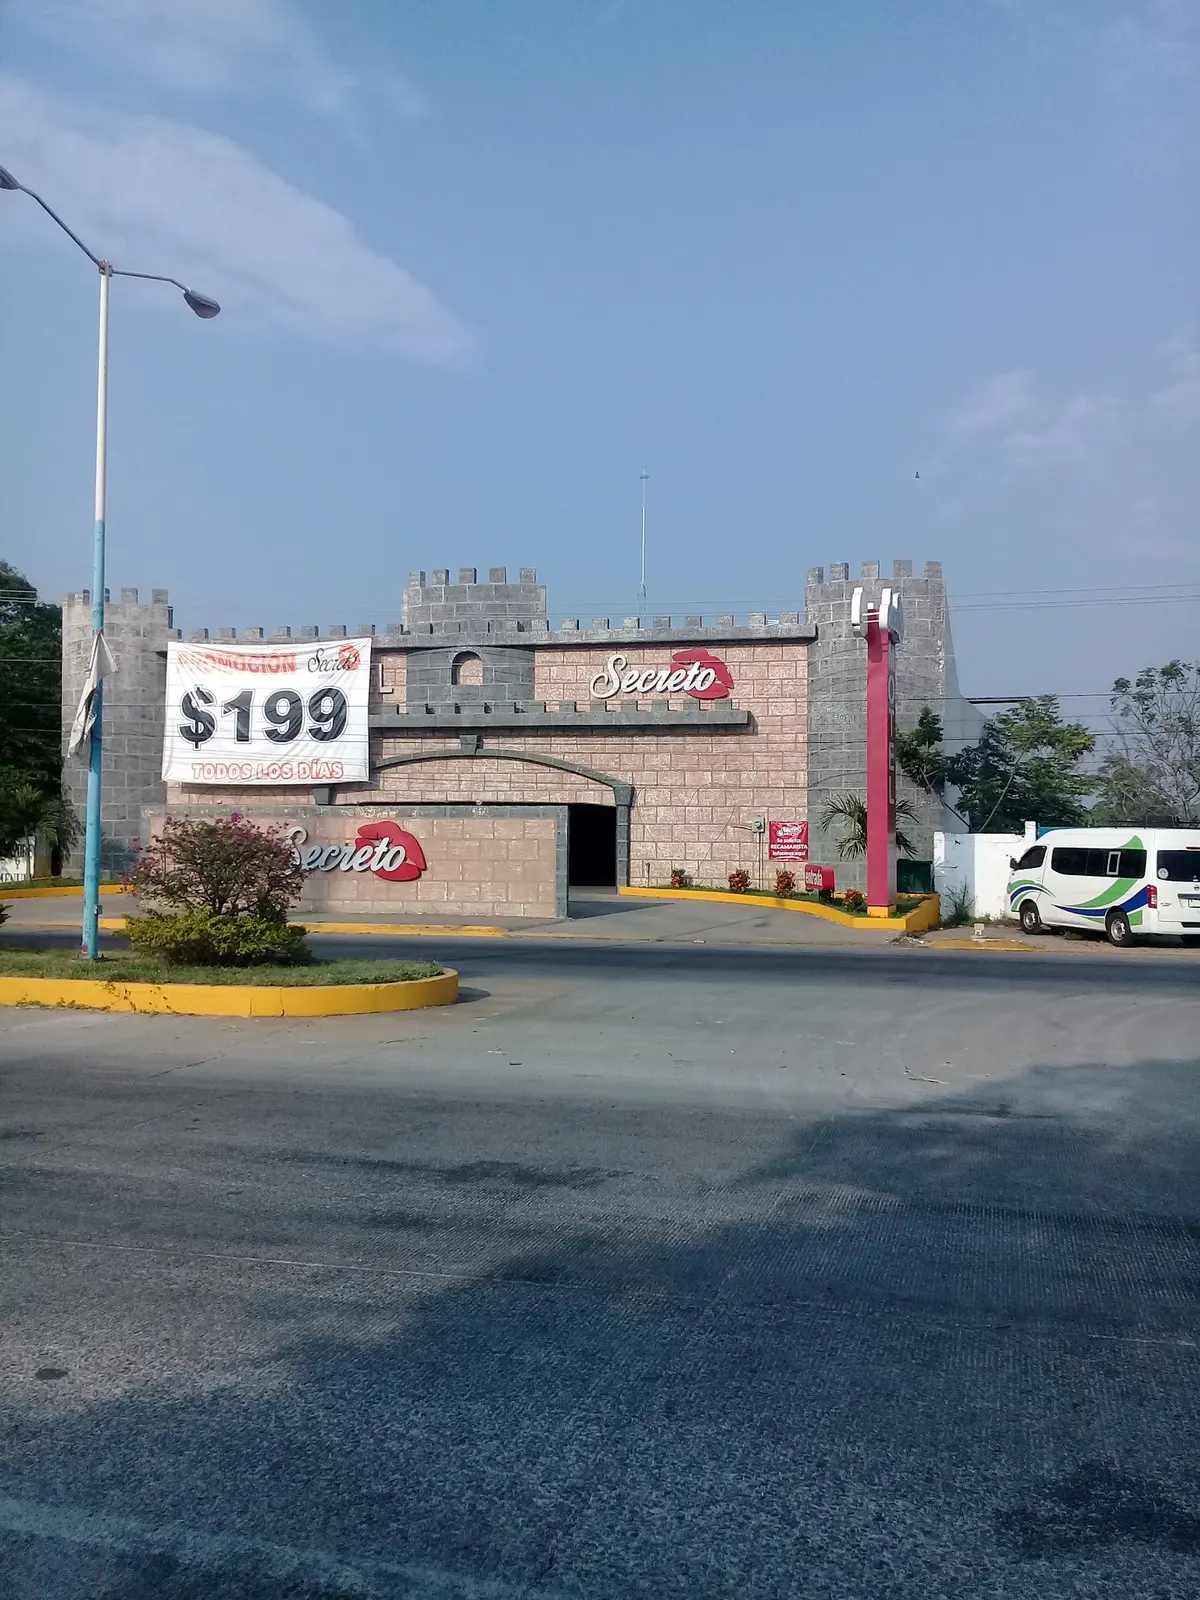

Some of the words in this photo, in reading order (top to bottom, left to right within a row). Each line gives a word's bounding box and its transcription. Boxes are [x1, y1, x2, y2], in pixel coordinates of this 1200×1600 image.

[177, 651, 297, 674] OMOCIÓN
[589, 654, 716, 699] Secreto
[177, 684, 350, 751] $199
[192, 763, 252, 779] TODOS
[256, 762, 294, 779] LOS
[298, 758, 344, 779] DÍAS
[284, 826, 406, 874] Secreto
